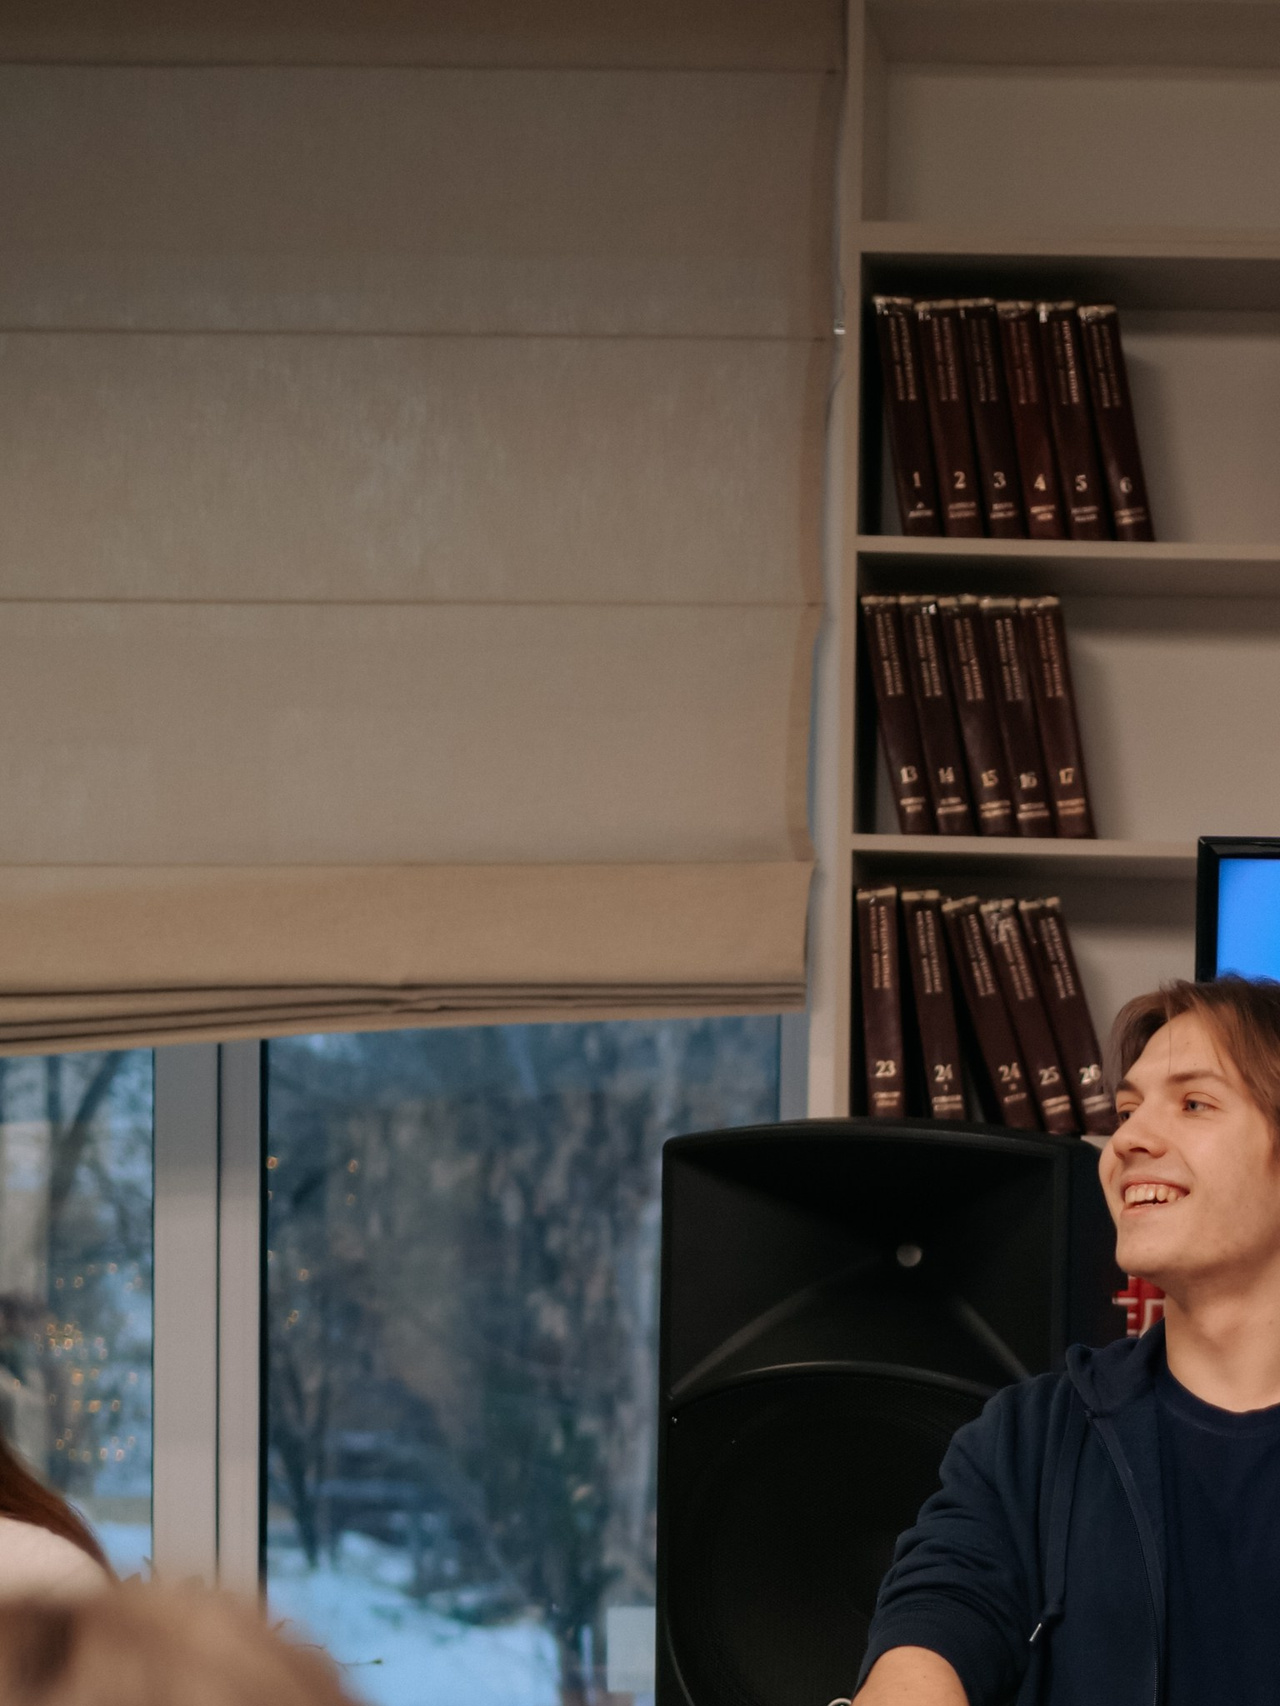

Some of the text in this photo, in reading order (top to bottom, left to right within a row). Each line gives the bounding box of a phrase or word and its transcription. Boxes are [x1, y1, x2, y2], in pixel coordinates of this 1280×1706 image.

[954, 471, 966, 489] 2
[993, 471, 1006, 488] 3
[1034, 473, 1046, 491] 4
[1075, 474, 1088, 492] 5
[1120, 476, 1133, 493] 6
[901, 765, 918, 784] 13
[981, 769, 999, 787] 15
[1020, 771, 1037, 789] 16
[1059, 767, 1075, 785] 17
[875, 1059, 896, 1078] 23
[934, 1063, 953, 1082] 24
[998, 1062, 1021, 1082] 24
[1039, 1065, 1060, 1086] 25
[1079, 1063, 1102, 1086] 26
